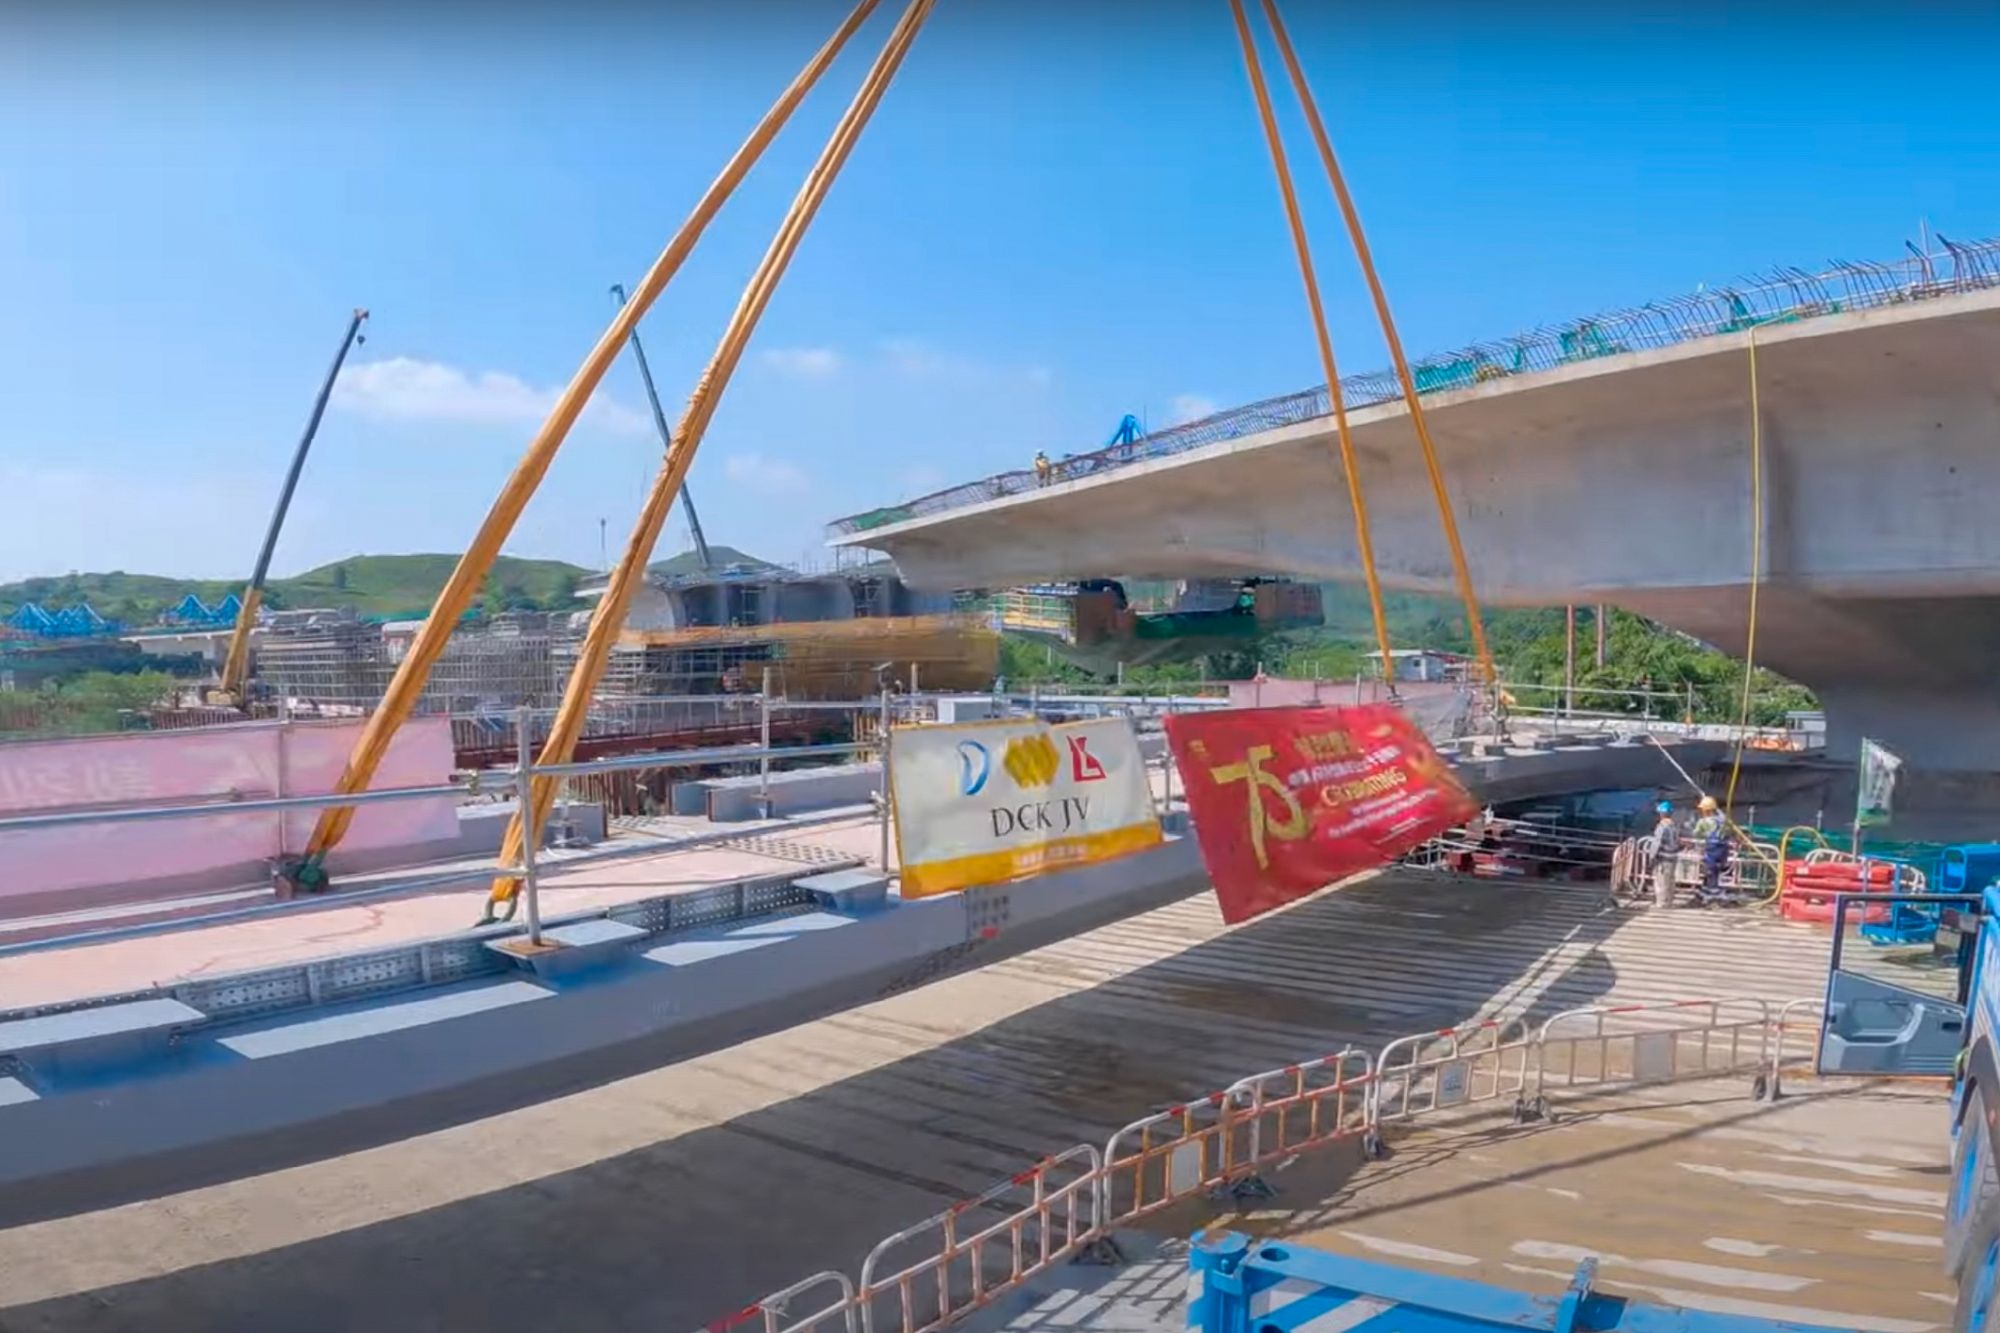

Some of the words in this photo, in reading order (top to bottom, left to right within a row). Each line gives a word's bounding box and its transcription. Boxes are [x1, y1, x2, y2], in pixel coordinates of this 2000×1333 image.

[991, 801, 1052, 837] DCK
[1060, 797, 1089, 832] JV
[1209, 744, 1309, 870] 75
